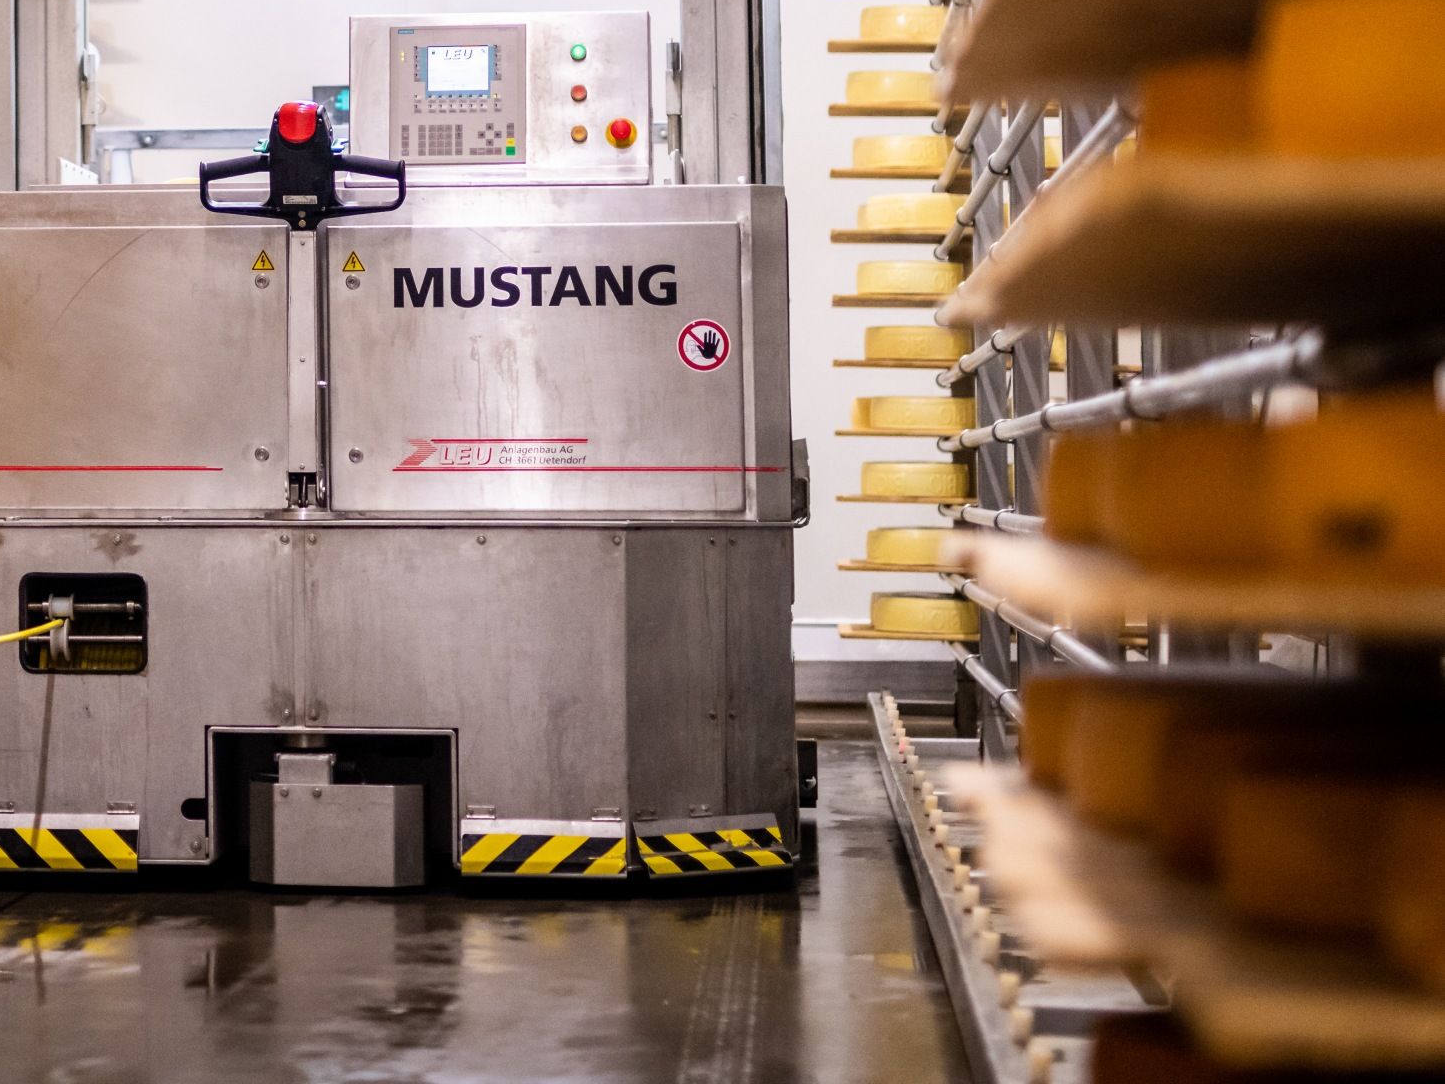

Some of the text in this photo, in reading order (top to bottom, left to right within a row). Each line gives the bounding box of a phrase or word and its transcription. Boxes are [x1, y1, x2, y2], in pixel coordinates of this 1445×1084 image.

[393, 264, 678, 308] MUSTANG
[439, 446, 492, 465] LEU
[500, 445, 574, 455] Anlagenbau AG
[539, 455, 587, 465] Uetendorf
